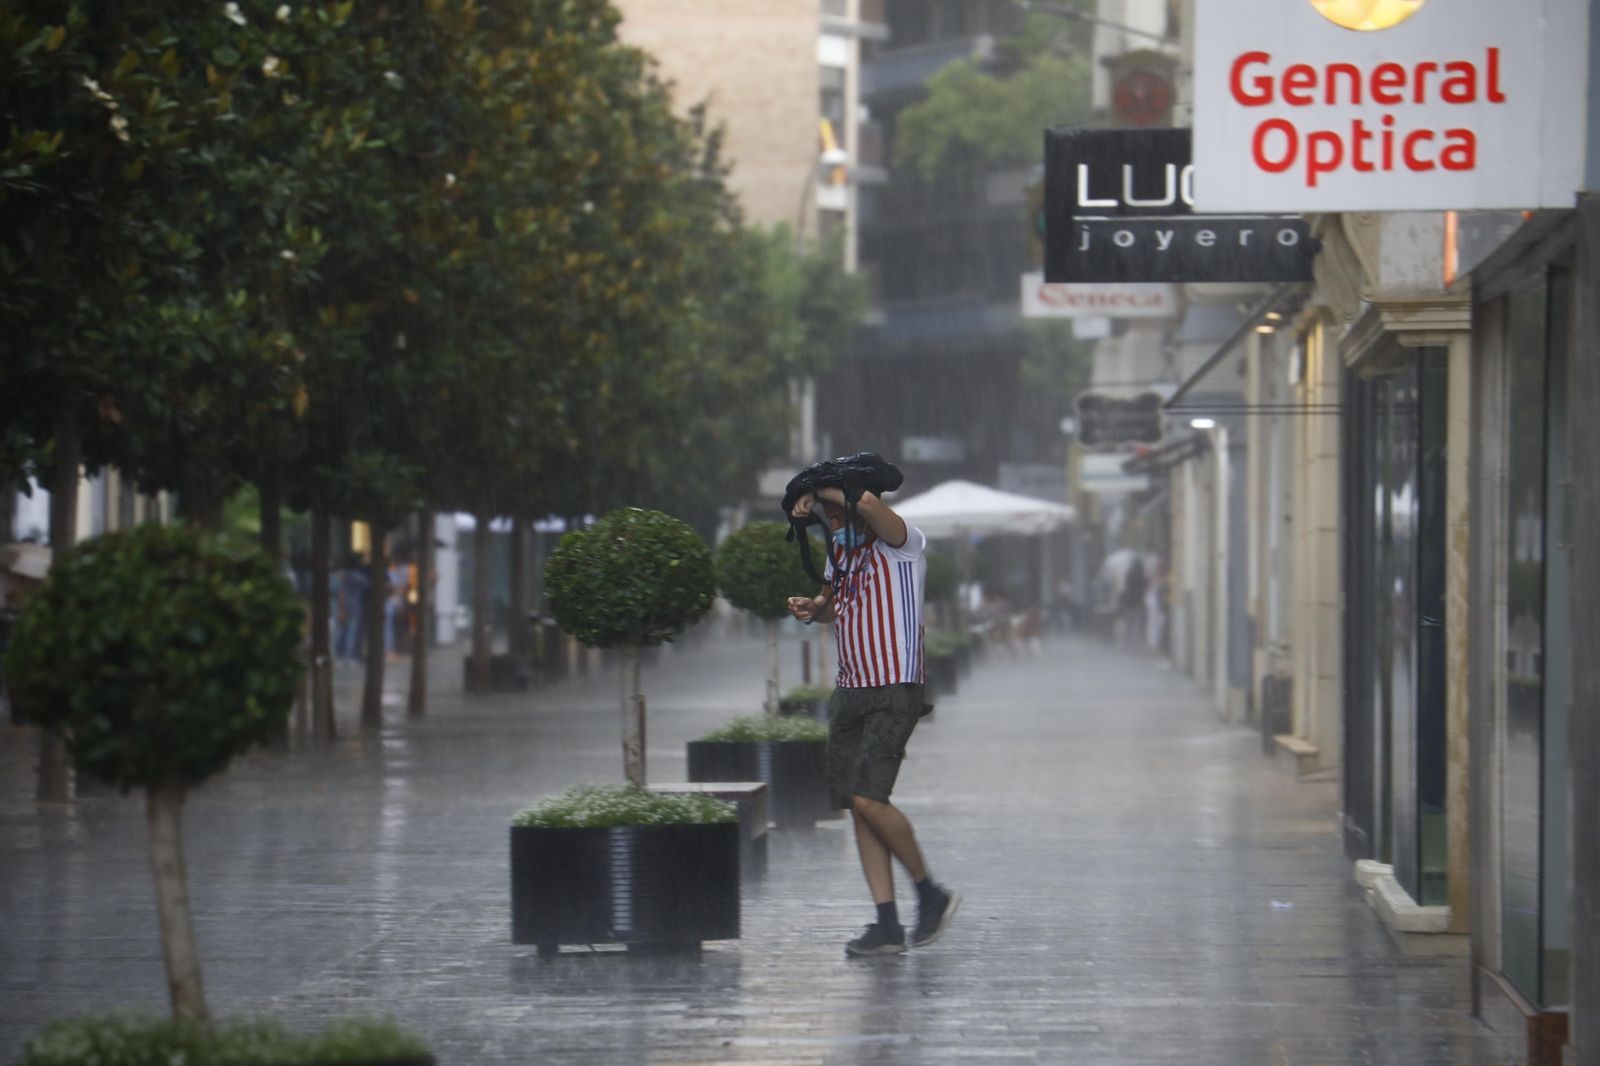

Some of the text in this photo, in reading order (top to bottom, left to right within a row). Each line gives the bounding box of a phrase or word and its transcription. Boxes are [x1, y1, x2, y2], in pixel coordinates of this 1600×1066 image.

[1229, 47, 1506, 107] General
[1251, 114, 1477, 188] Optica
[1078, 225, 1299, 251] joyero
